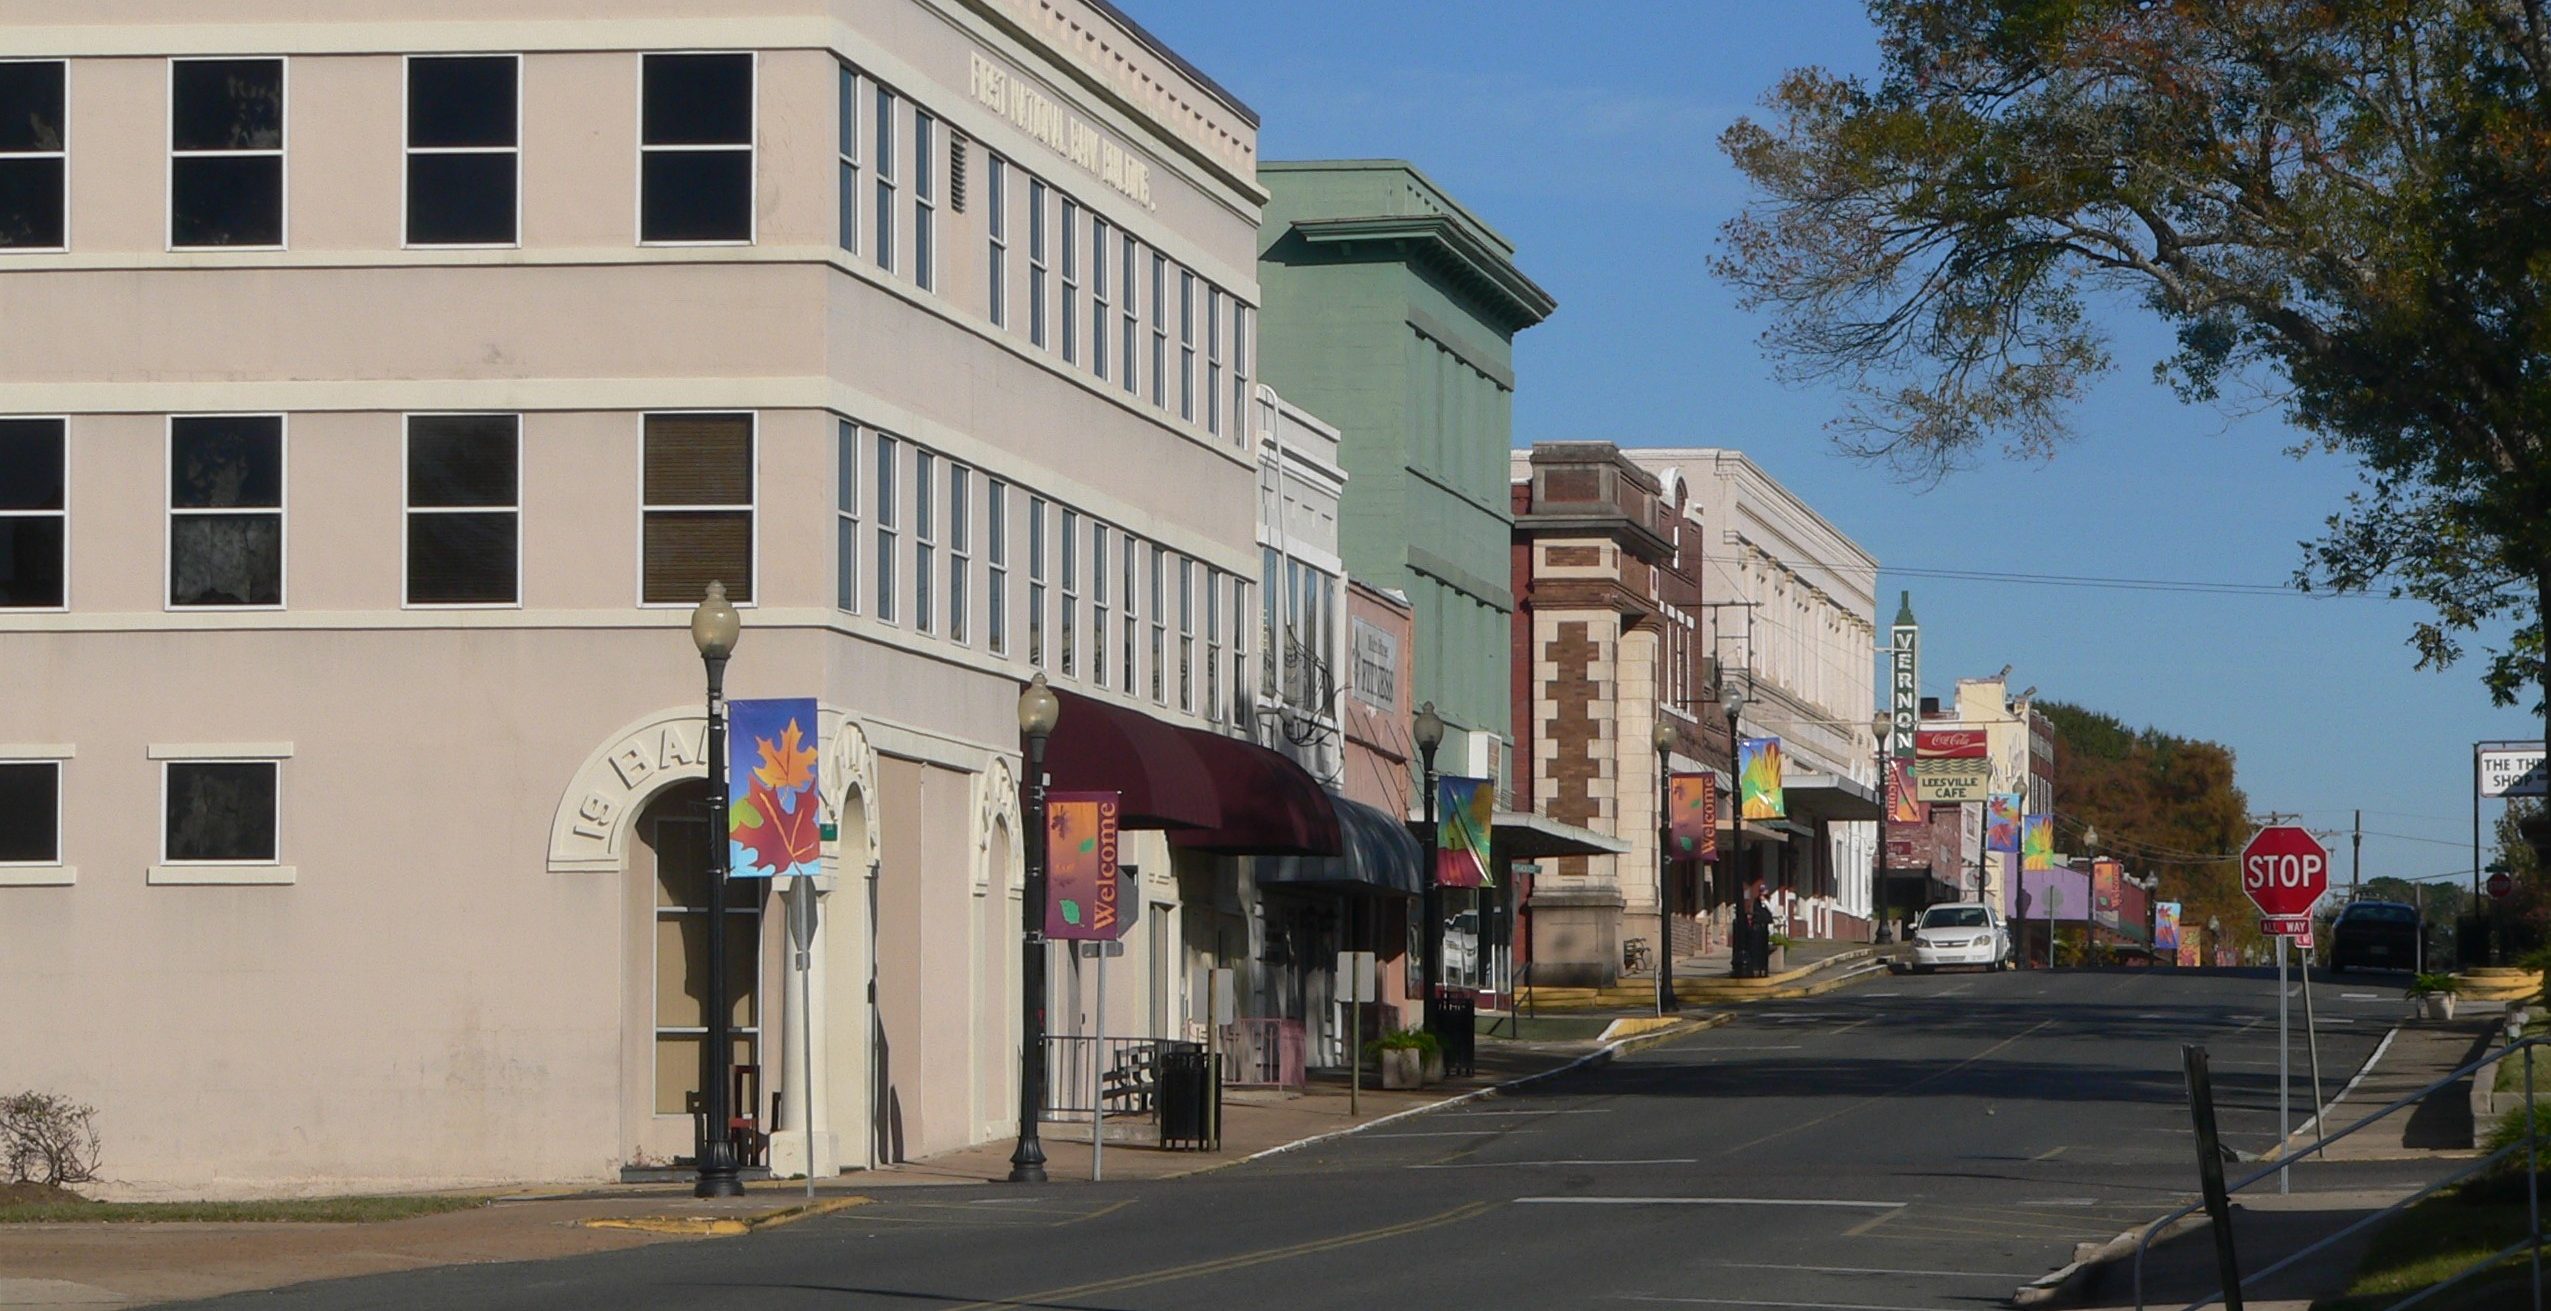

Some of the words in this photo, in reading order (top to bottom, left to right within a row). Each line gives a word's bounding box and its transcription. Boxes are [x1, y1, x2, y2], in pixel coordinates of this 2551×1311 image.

[1896, 633, 1913, 749] VERNON
[2484, 758, 2511, 772] THE
[1921, 777, 1979, 787] LEESVILLE
[2493, 774, 2533, 787] SHOP
[1935, 787, 1968, 799] CAFE
[1702, 776, 1715, 855] Welcome
[1093, 802, 1116, 931] Welcome
[2247, 854, 2322, 888] STOP
[2263, 922, 2280, 933] ALL
[2285, 921, 2306, 933] WAY
